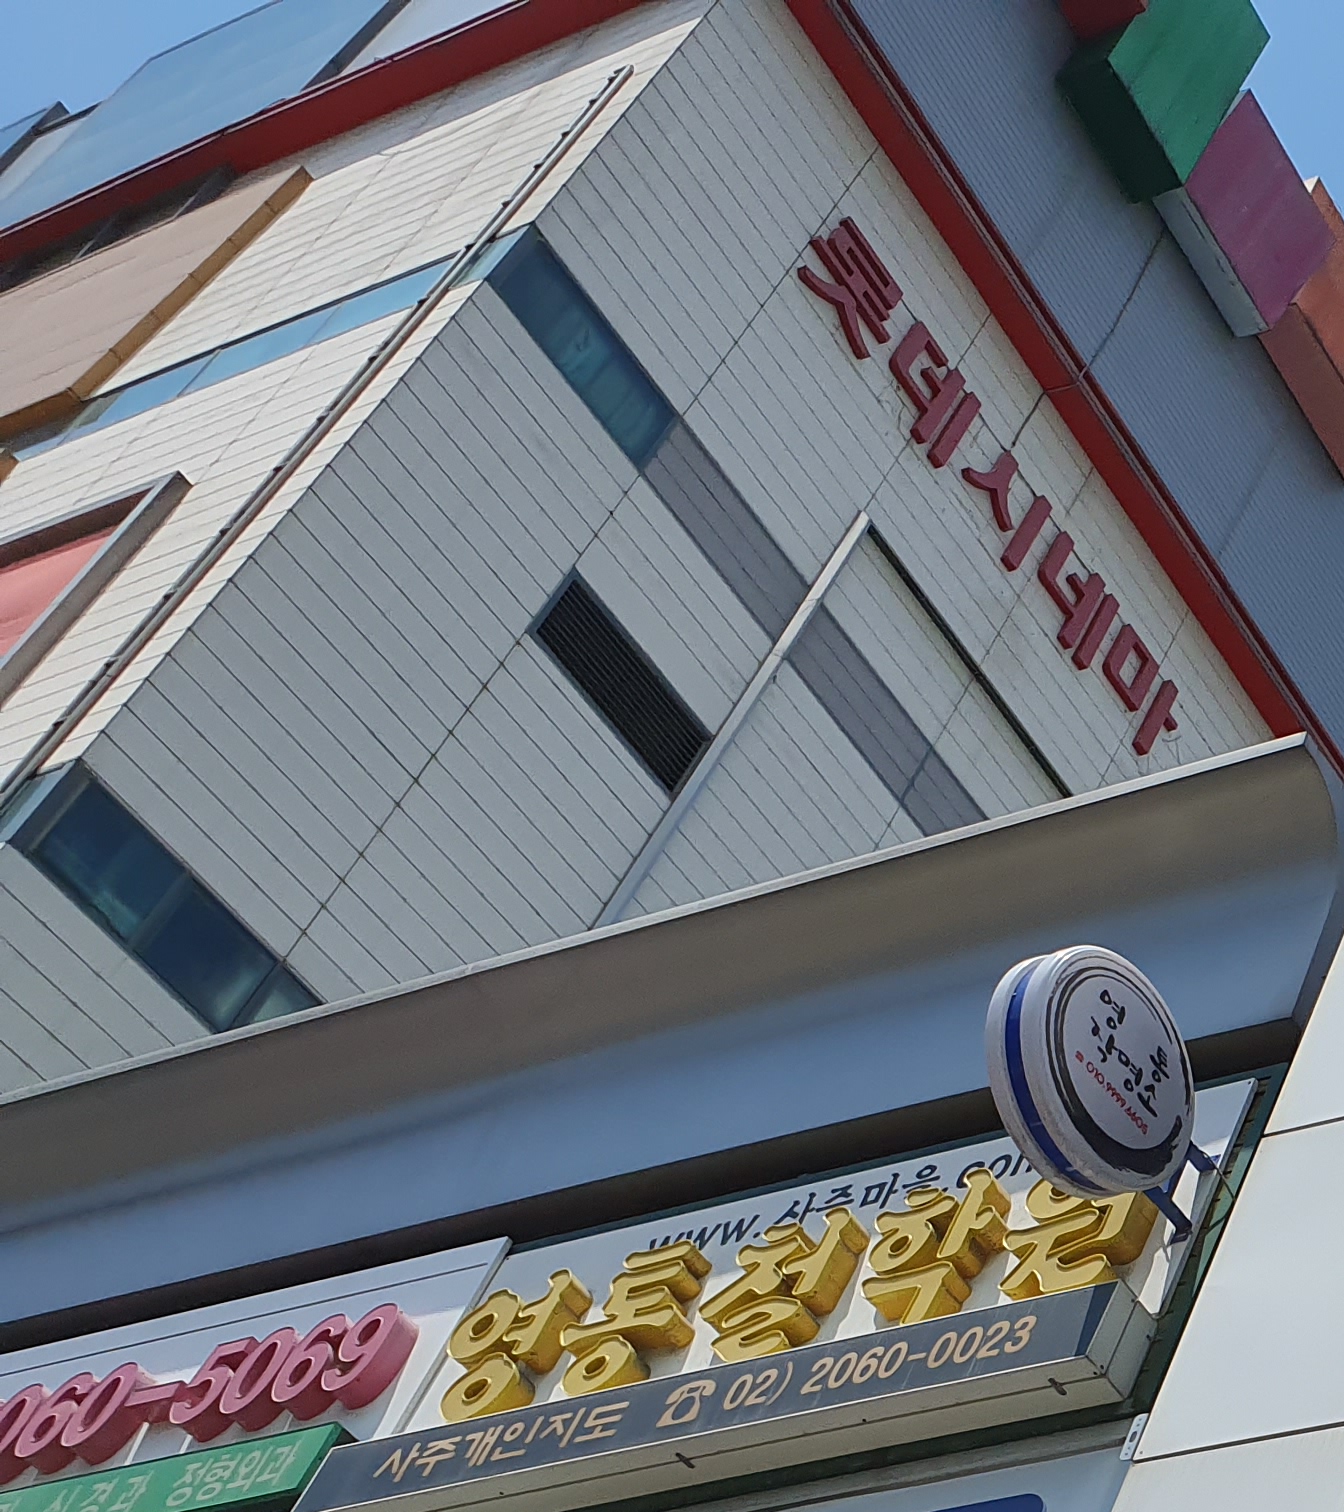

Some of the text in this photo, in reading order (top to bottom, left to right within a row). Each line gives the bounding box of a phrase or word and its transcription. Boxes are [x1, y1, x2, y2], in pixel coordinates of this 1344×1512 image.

[797, 216, 1179, 756] 롯데시네마
[1090, 1015, 1159, 1118] 작명소
[441, 1167, 1150, 1422] 영통철학원
[166, 1441, 300, 1508] 정형외과
[372, 1316, 1038, 1483] 사주개인지도 02) 2060-0023
